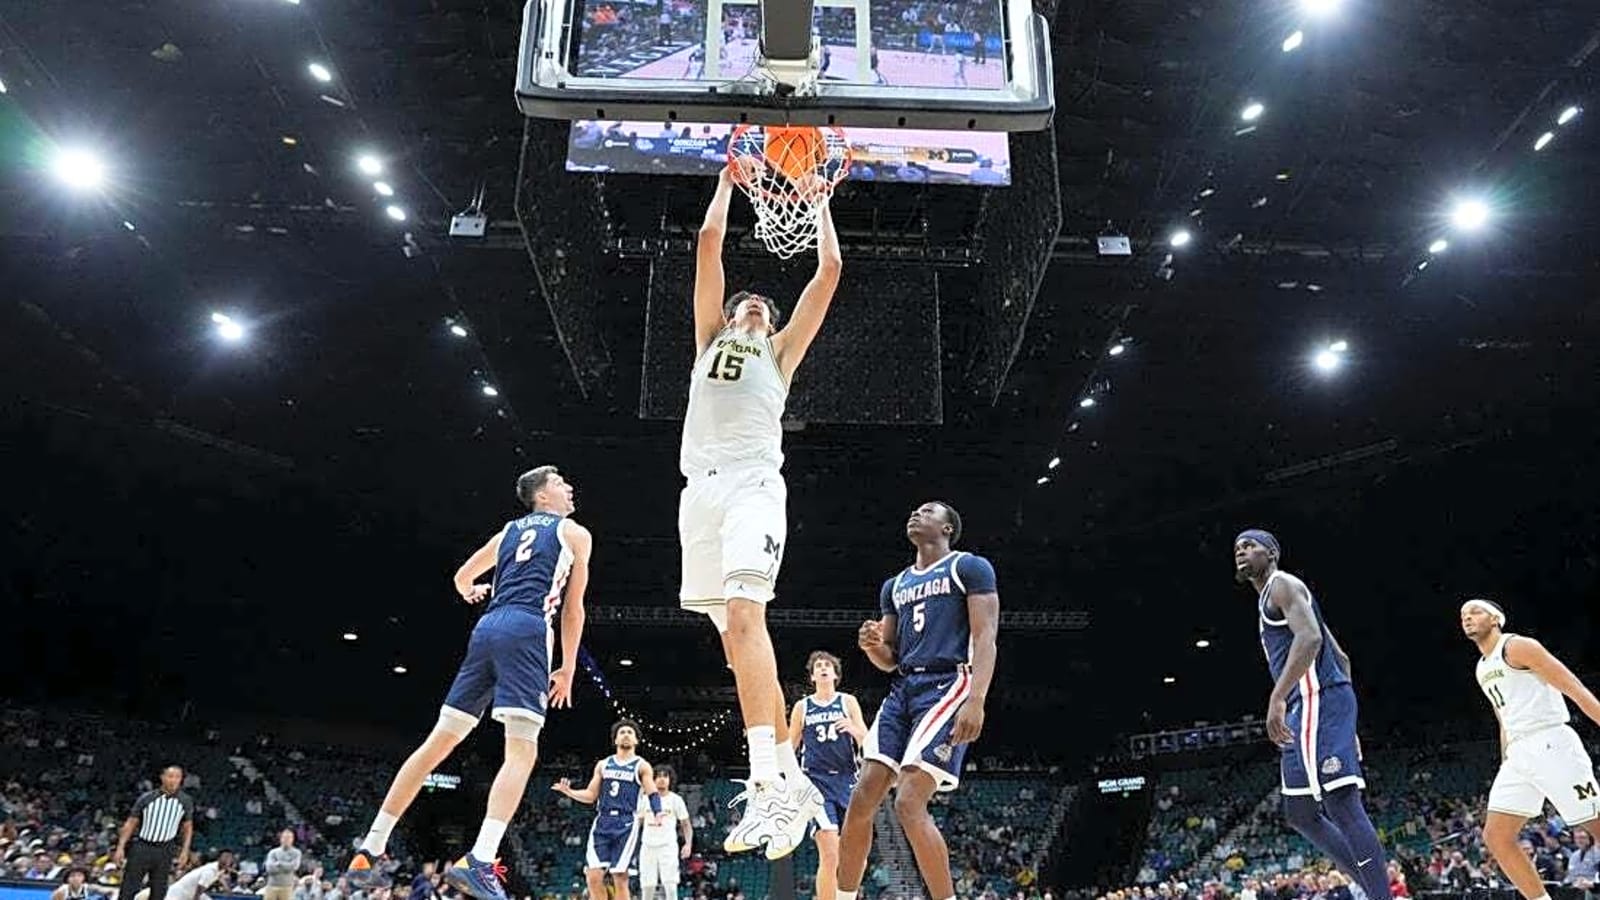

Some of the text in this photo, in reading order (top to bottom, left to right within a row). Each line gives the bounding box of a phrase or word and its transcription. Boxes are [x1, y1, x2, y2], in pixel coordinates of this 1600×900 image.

[707, 350, 746, 382] 15
[515, 527, 538, 563] 2
[763, 533, 781, 561] M
[894, 577, 951, 605] GONZAGA
[912, 602, 926, 633] 5
[1488, 684, 1506, 710] 11
[815, 723, 840, 744] 34
[602, 769, 636, 783] GONZAGA
[609, 780, 620, 798] 3
[1098, 776, 1145, 788] MGM GRAND
[1573, 781, 1598, 801] M
